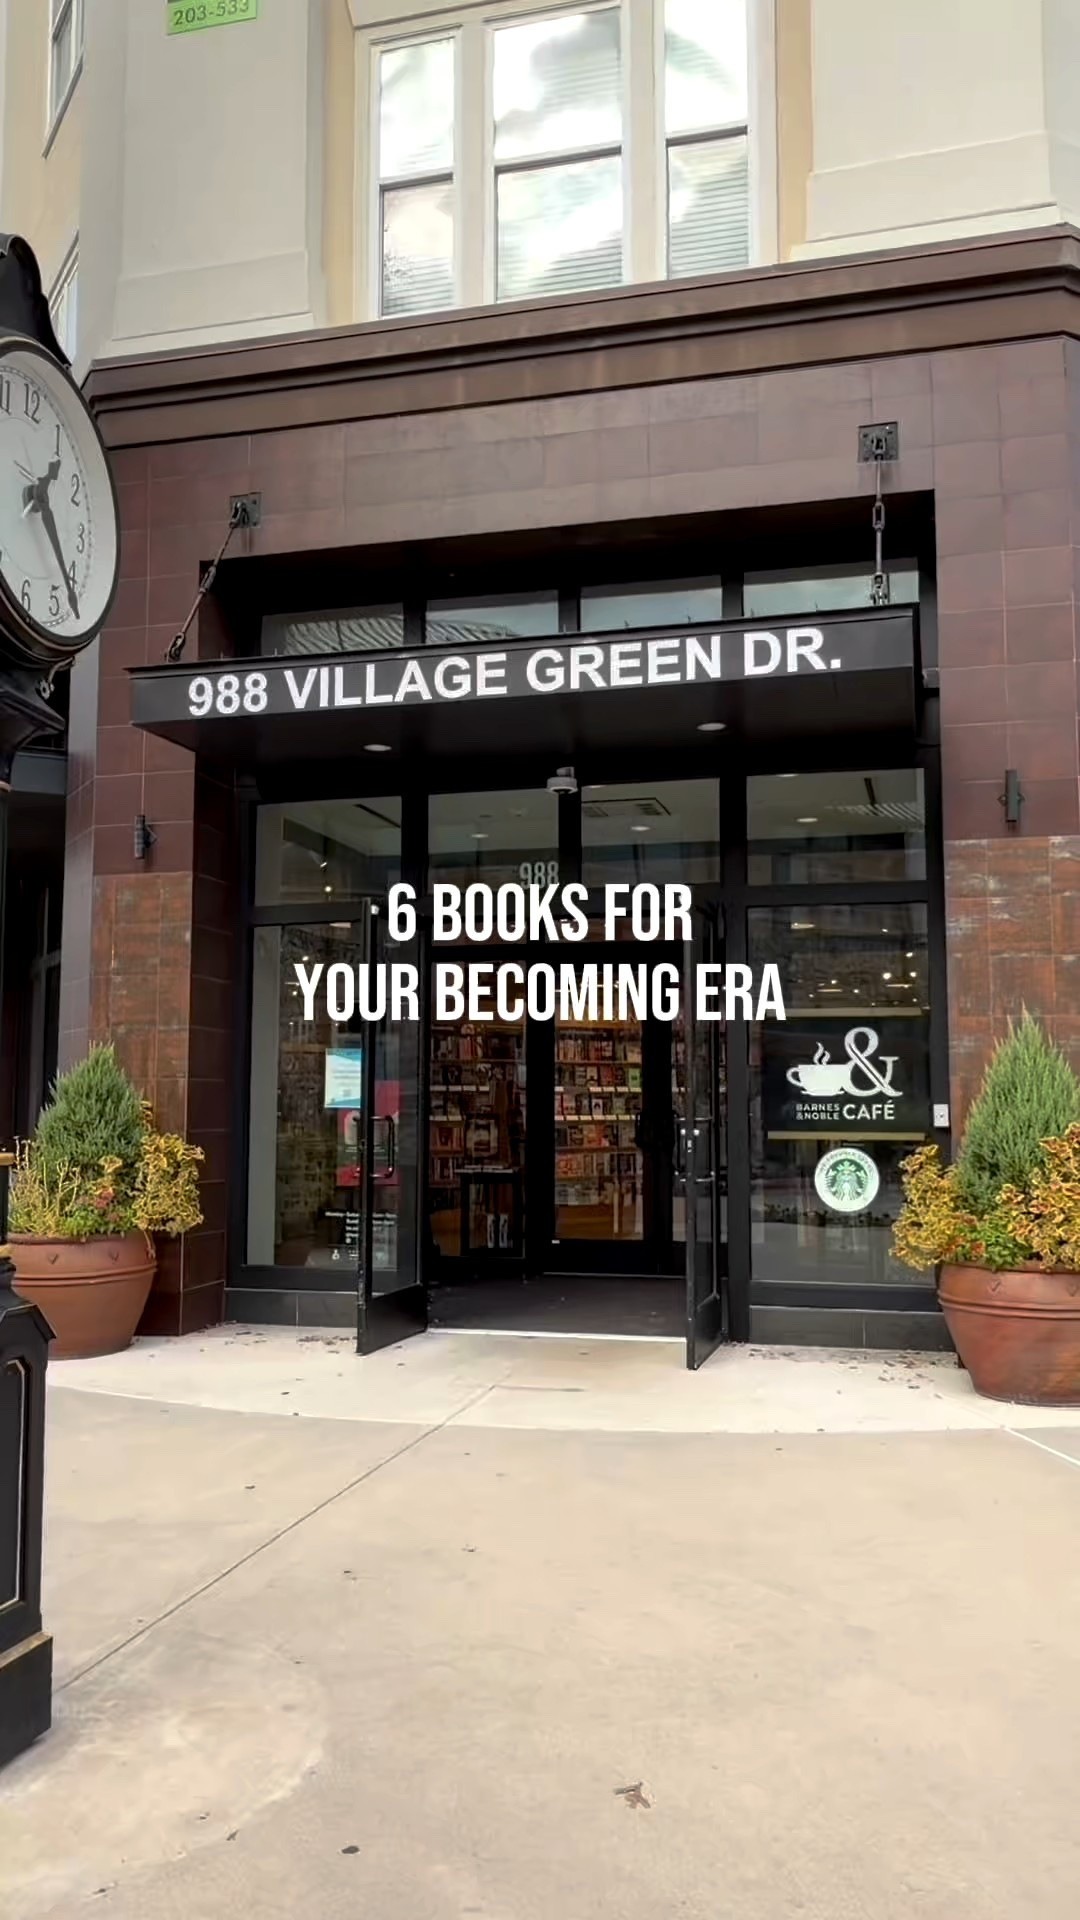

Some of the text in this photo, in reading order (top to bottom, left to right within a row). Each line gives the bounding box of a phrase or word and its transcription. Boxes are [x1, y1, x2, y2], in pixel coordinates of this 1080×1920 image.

[23, 383, 41, 424] 12
[55, 424, 62, 457] 1
[70, 473, 80, 507] 2
[76, 522, 85, 554] 3
[21, 579, 31, 612] 6
[48, 584, 60, 617] 5
[188, 628, 841, 716] 988 VILLAGE GREEN DR.
[520, 861, 559, 889] 988
[796, 1103, 840, 1111] BARNES
[842, 1100, 895, 1120] CAFÉ
